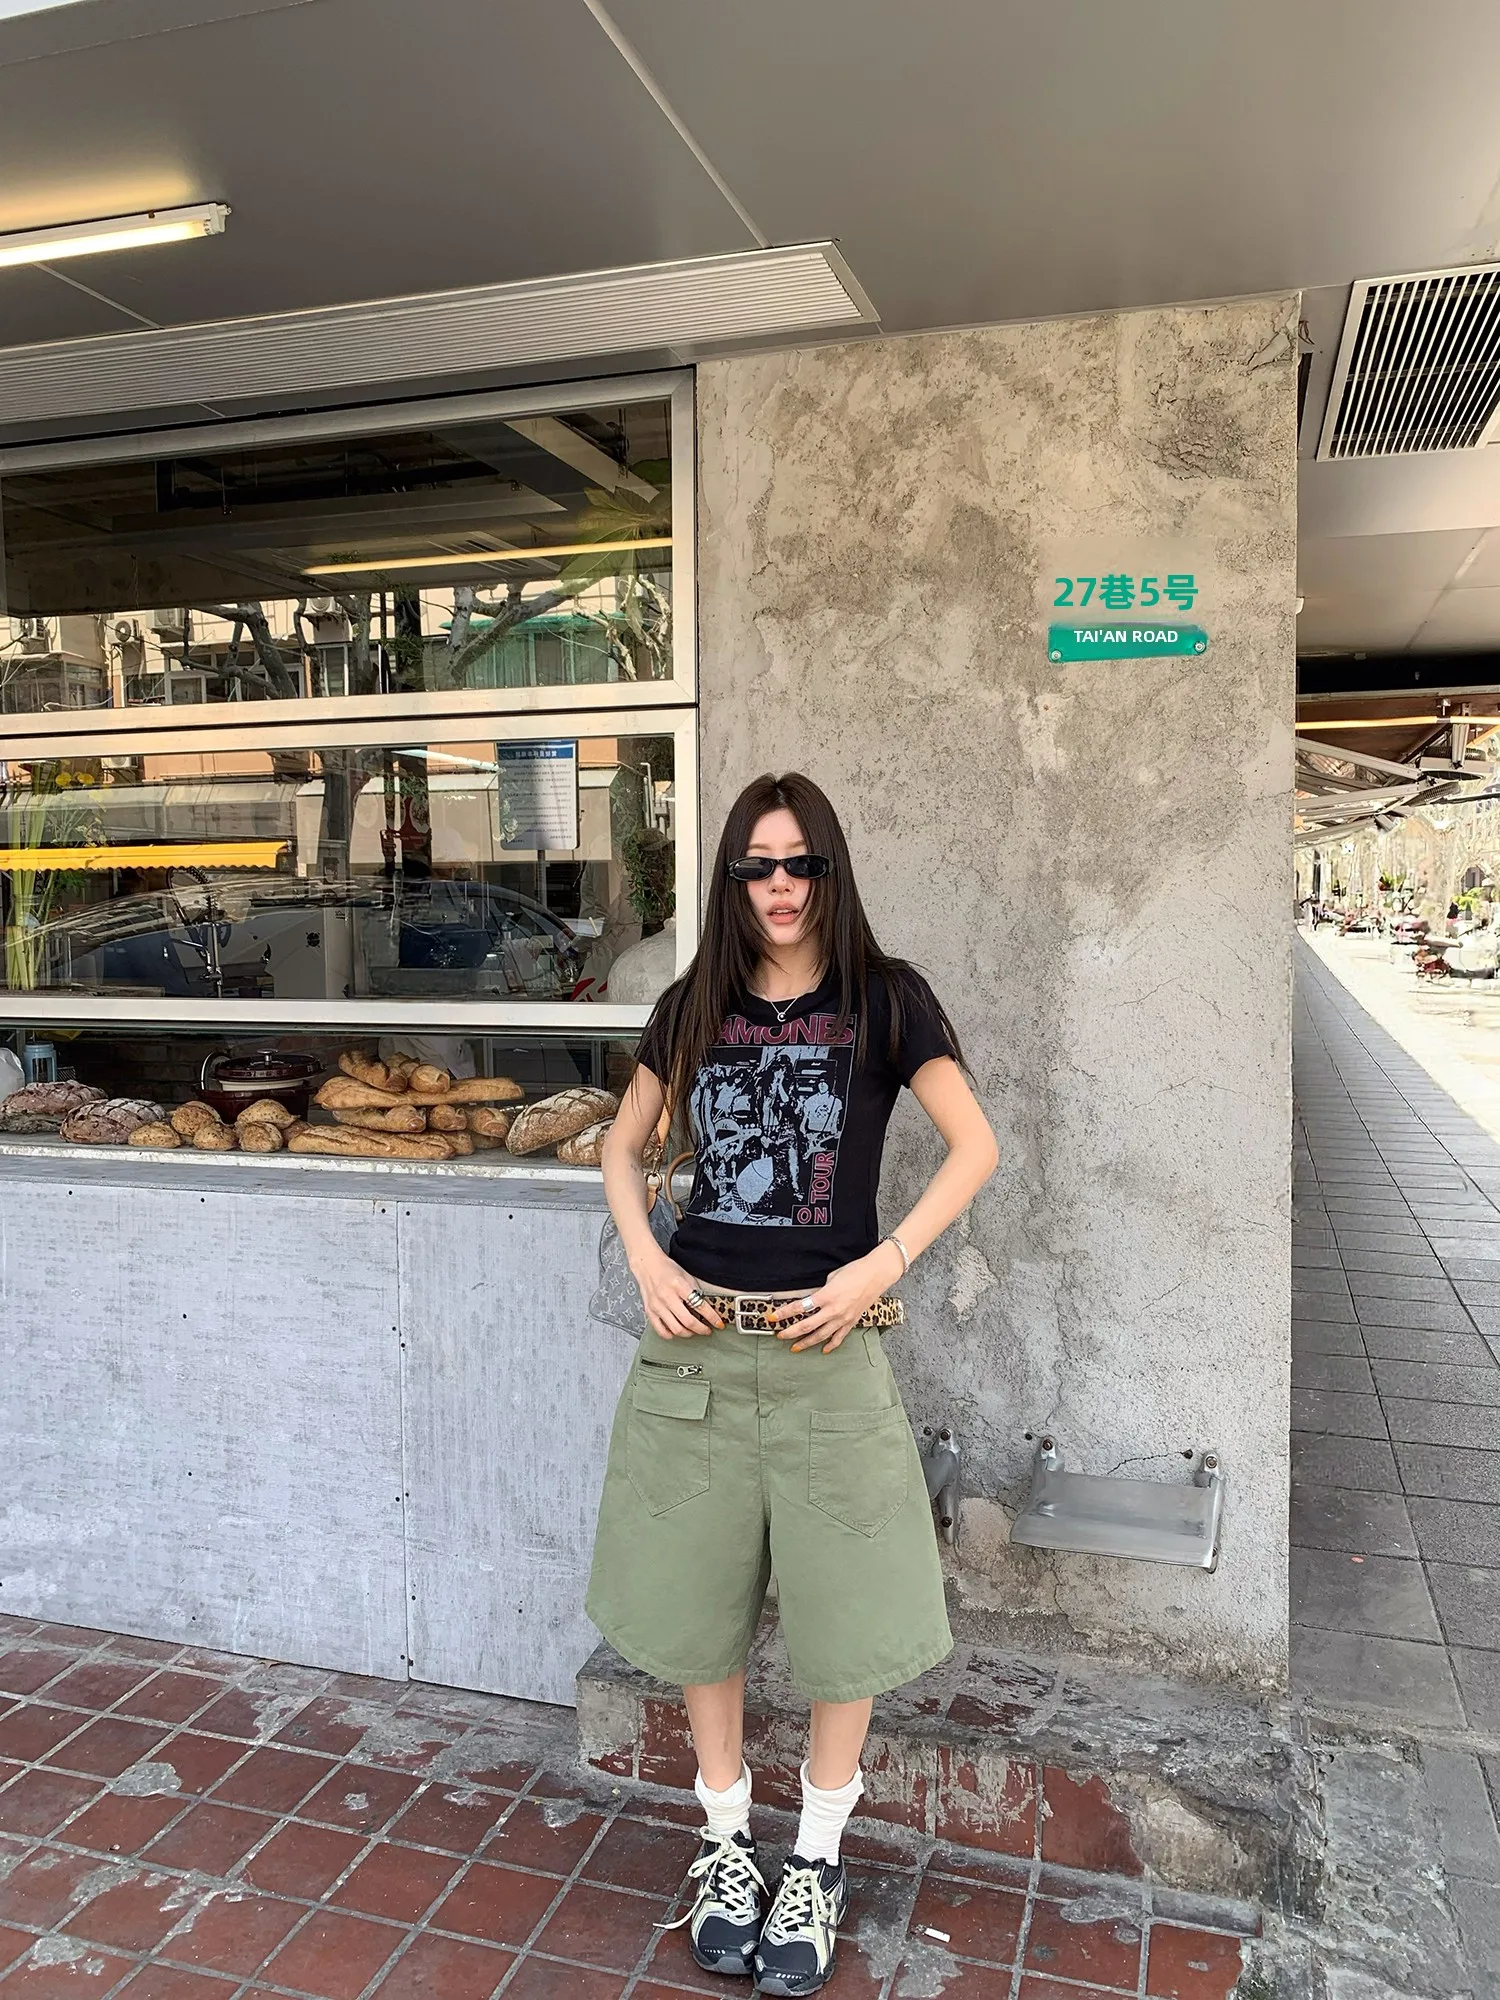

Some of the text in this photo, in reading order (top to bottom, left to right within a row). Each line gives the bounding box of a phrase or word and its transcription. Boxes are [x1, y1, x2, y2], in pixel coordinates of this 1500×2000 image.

[1053, 574, 1199, 610] 27巷5号
[1074, 630, 1178, 643] TAI'AN ROAD
[707, 1015, 855, 1045] AMONES
[810, 1151, 835, 1204] TOUR
[797, 1207, 828, 1225] ON
